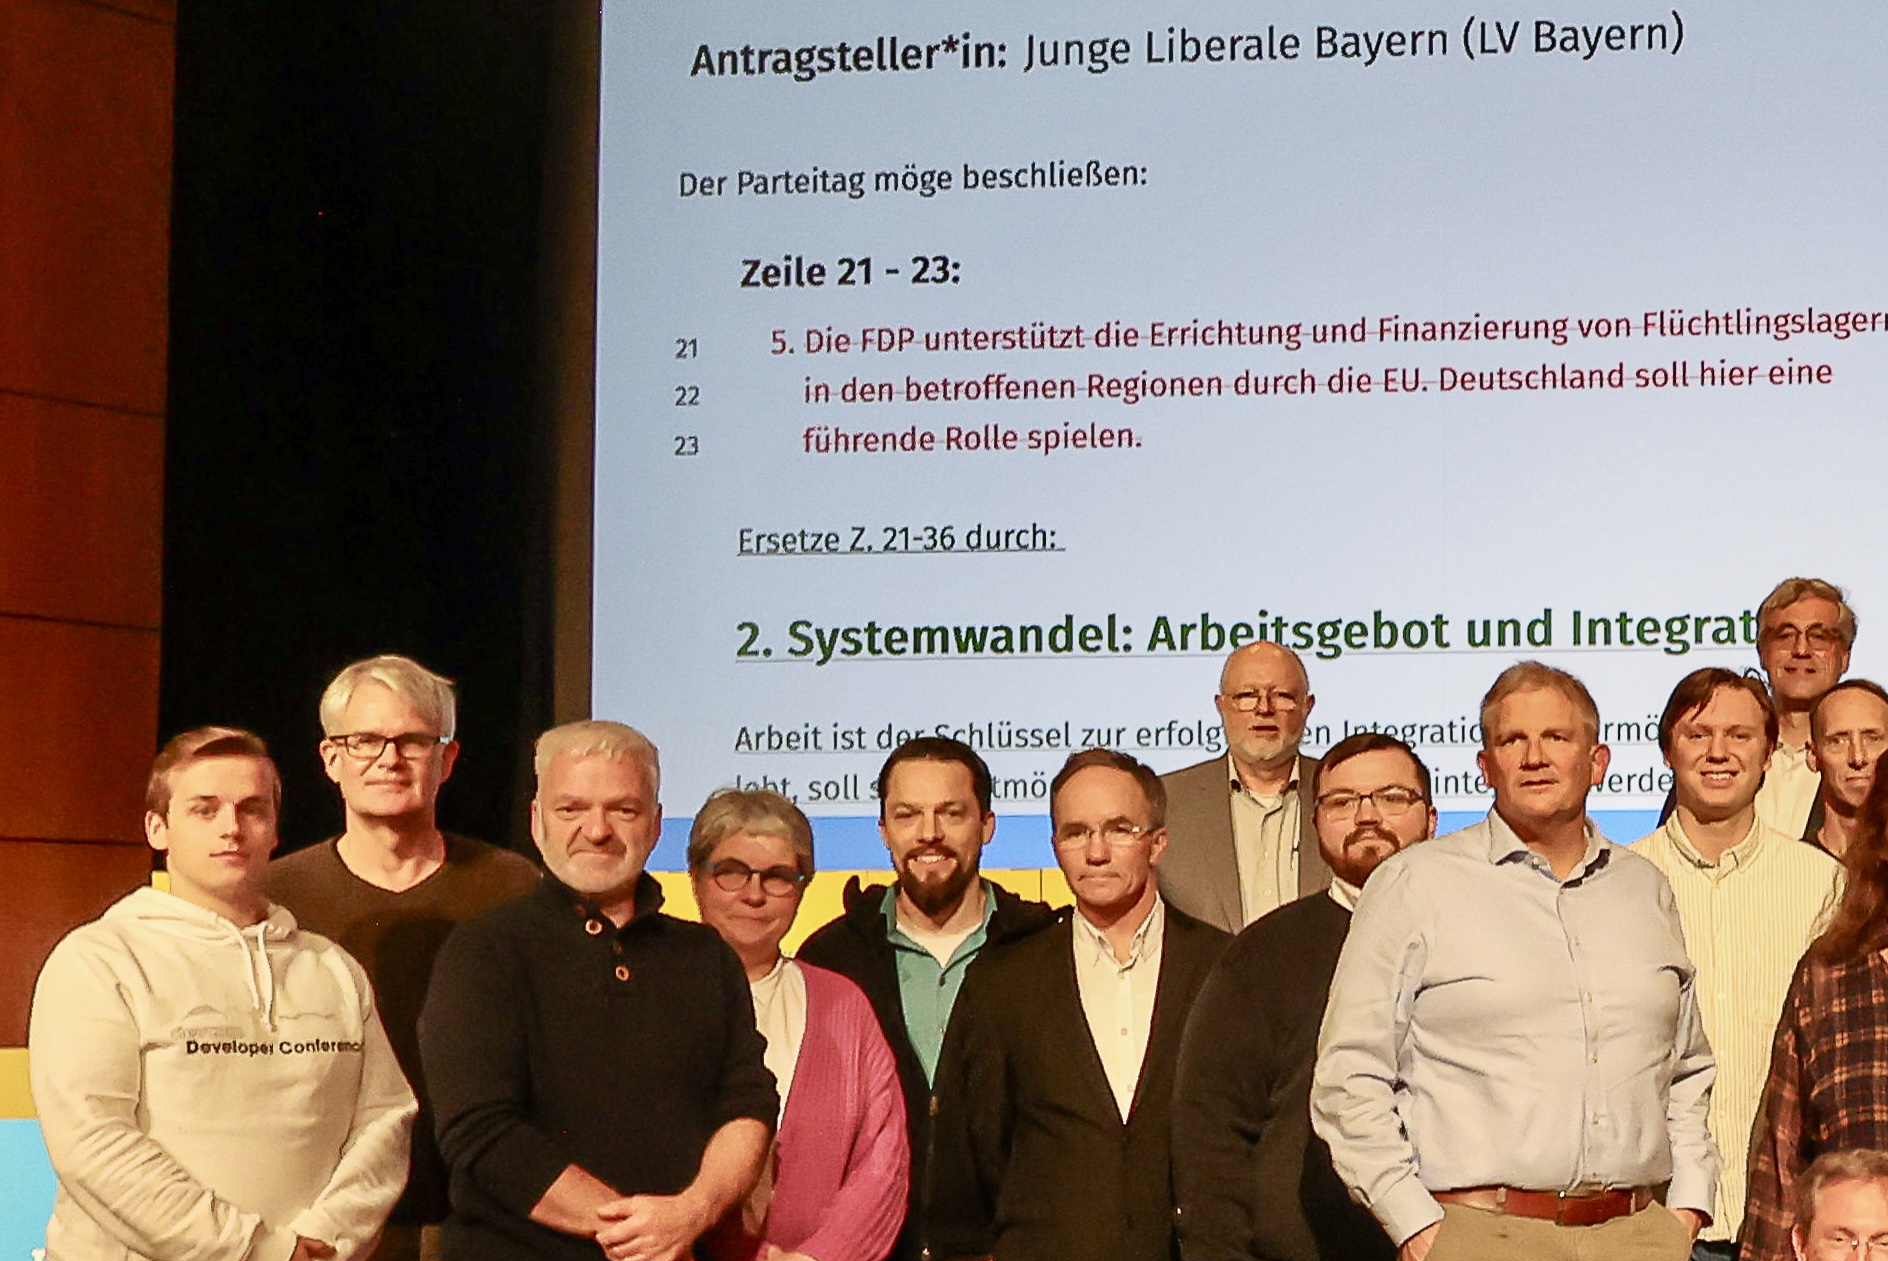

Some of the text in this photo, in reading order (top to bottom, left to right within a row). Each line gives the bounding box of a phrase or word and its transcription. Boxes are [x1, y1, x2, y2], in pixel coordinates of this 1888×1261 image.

[1024, 35, 1130, 74] Junge
[1147, 25, 1300, 63] Liberale
[1317, 26, 1447, 67] Bayern
[1464, 16, 1519, 60] (LV
[1535, 10, 1683, 60] Bayern)
[680, 160, 1146, 199] Der Parteitag möge beschließen:
[741, 255, 826, 288] Zeile
[838, 257, 871, 285] 21
[912, 256, 960, 284] 23:
[676, 338, 697, 358] 21
[771, 330, 794, 354] 5.
[807, 326, 850, 353] Die
[862, 328, 914, 352] FDP
[925, 322, 1085, 351] unterstützt
[1095, 321, 1139, 347] die
[1151, 319, 1301, 351] Errichtung
[1313, 317, 1365, 343] und
[1380, 313, 1568, 345] Finanzierung
[1578, 318, 1630, 337] von
[675, 386, 699, 406] 22
[805, 358, 1832, 404] in den betroffenen Regionen durch die EU. Deutschland soll hier eine
[675, 436, 699, 455] 23
[803, 422, 1141, 455] führende Rolle spielen.
[738, 527, 839, 554] Ersetze
[882, 525, 956, 551] 21-36
[966, 522, 1058, 550] durch:
[737, 622, 772, 657] 2.
[788, 613, 1132, 666] Systemwandel:
[1468, 608, 1552, 648] und
[735, 723, 822, 751] Arbeit
[833, 723, 866, 750] ist
[1082, 725, 1125, 747] zur
[809, 774, 859, 801] soll
